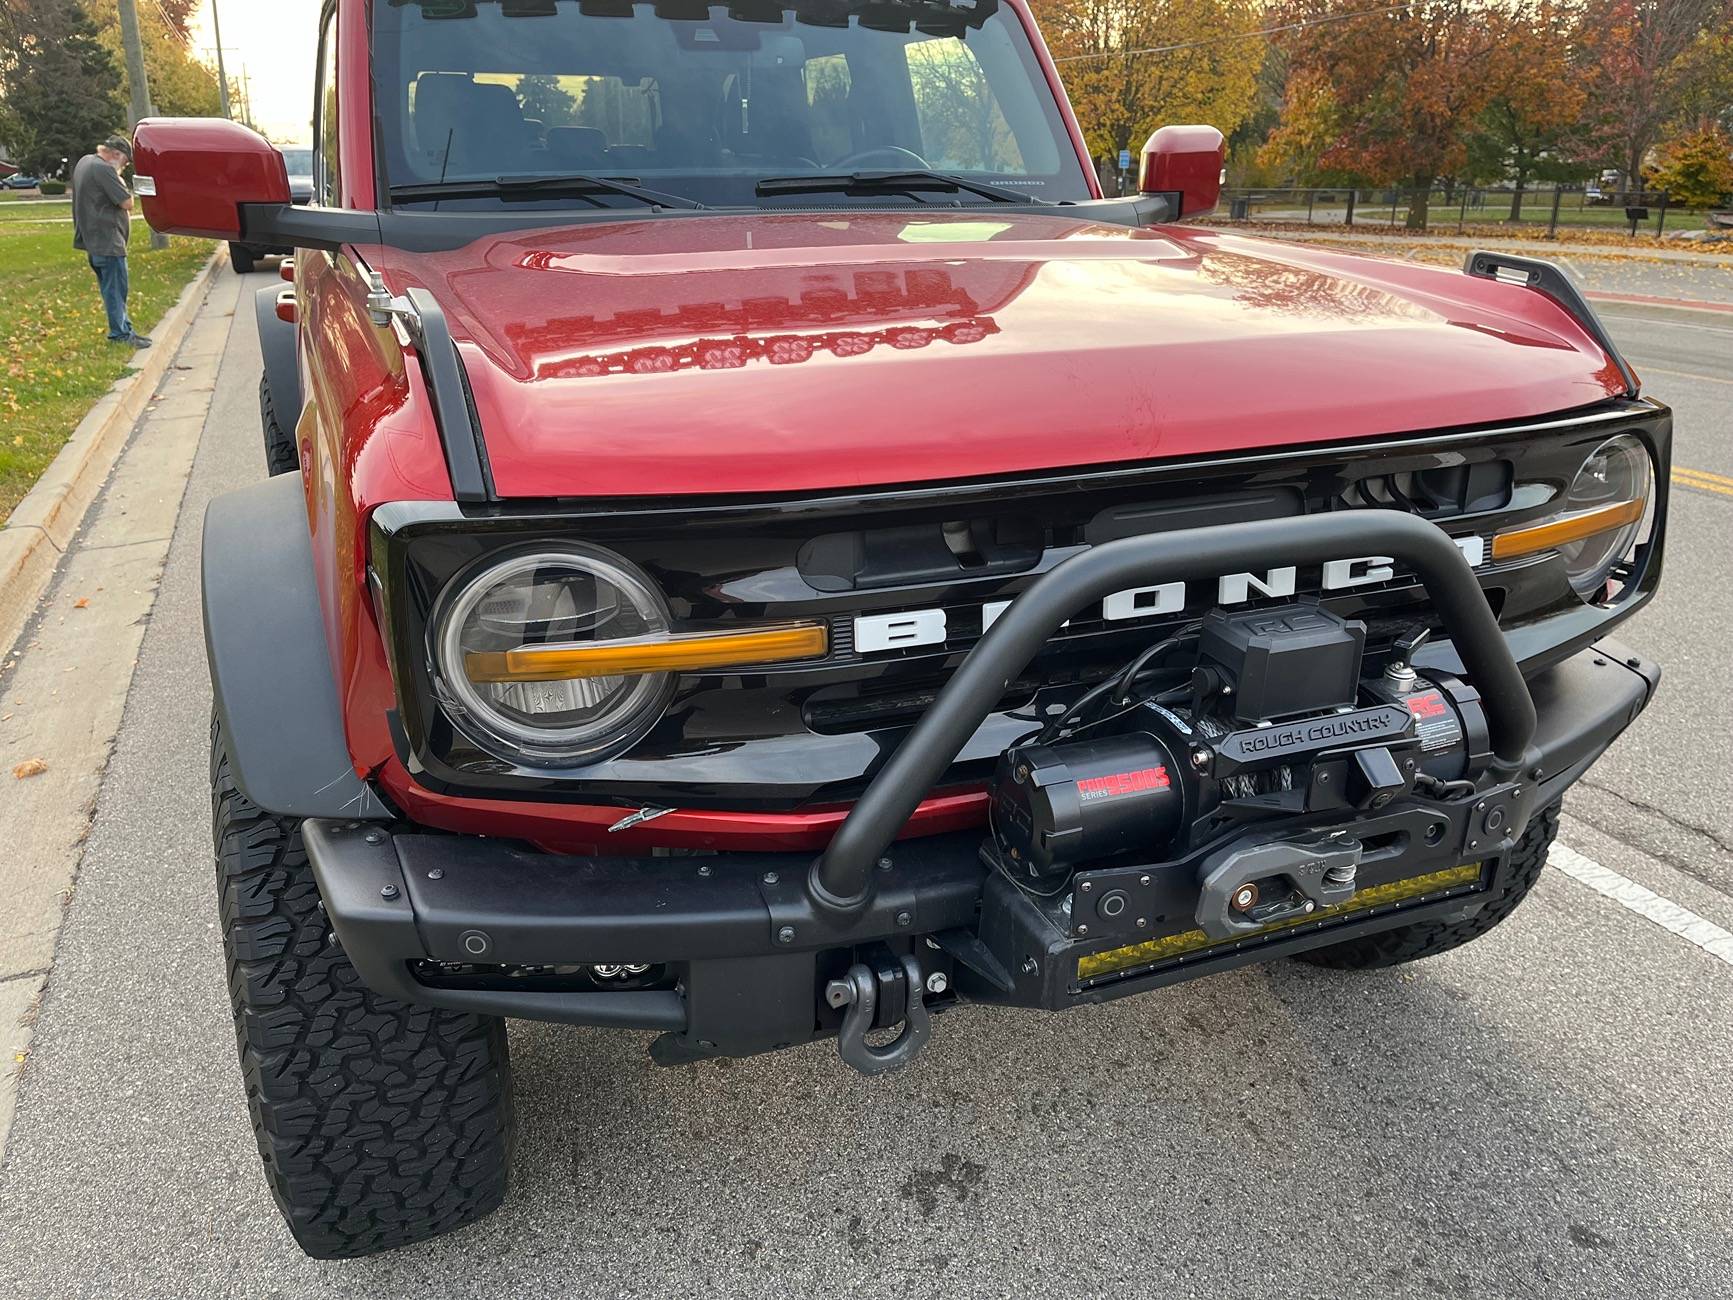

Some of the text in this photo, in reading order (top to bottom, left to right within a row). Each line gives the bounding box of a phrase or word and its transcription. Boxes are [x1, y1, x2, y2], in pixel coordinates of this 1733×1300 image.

[1240, 731, 1304, 753] ROUGH
[1308, 714, 1391, 741] COUNTRY
[1080, 789, 1108, 801] SERIES
